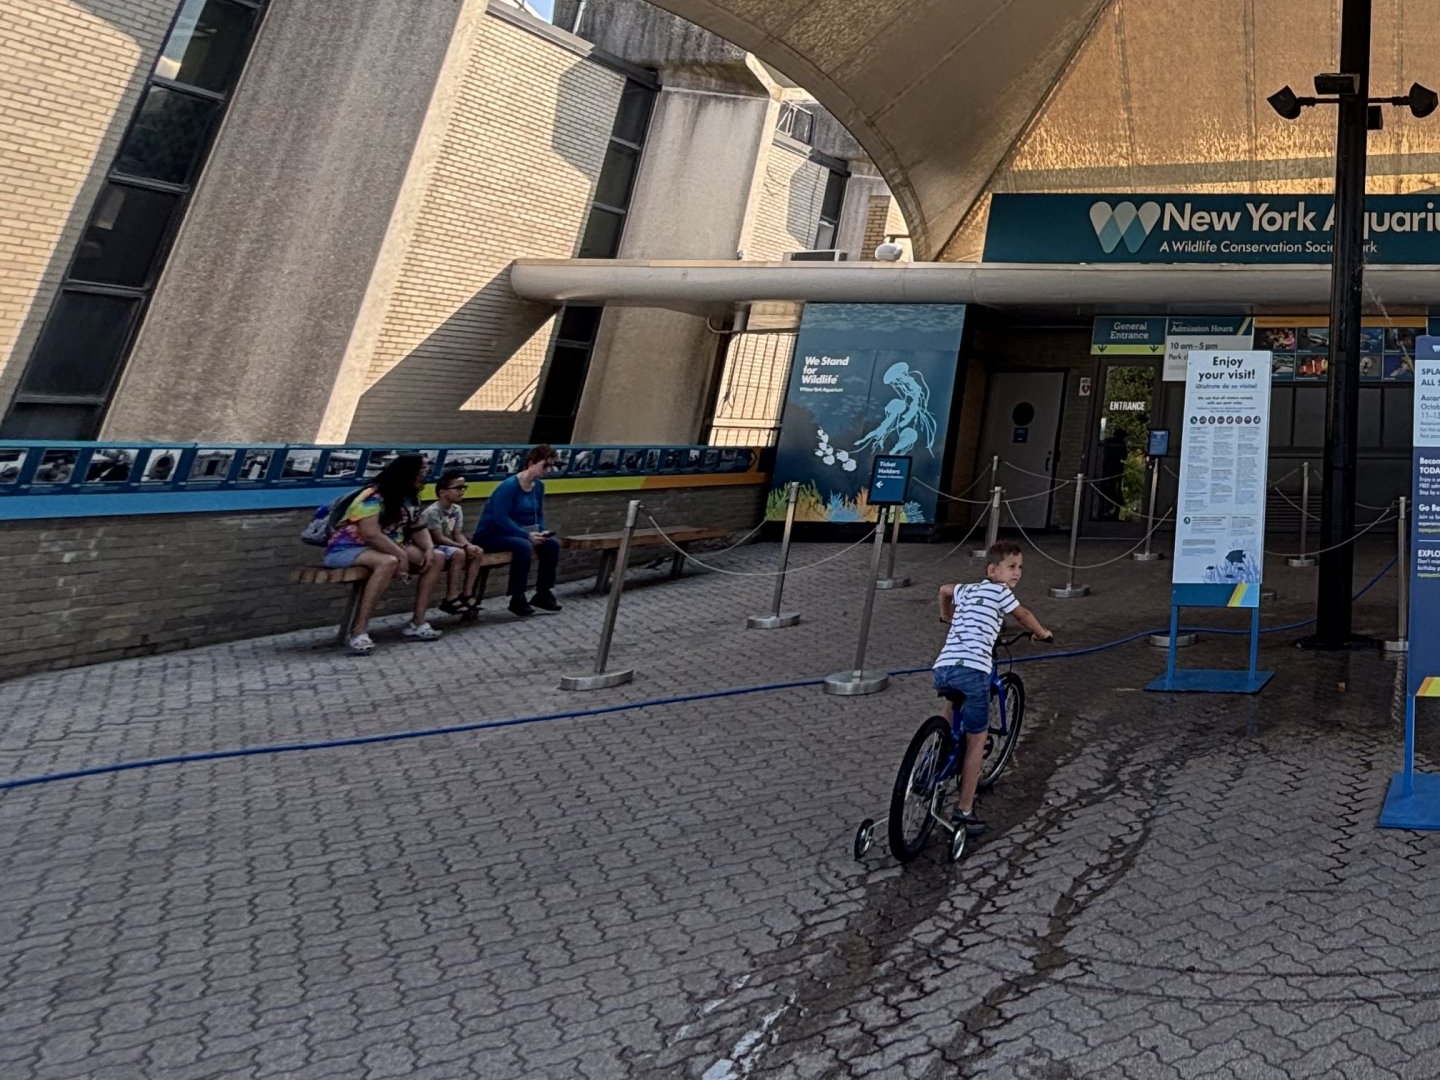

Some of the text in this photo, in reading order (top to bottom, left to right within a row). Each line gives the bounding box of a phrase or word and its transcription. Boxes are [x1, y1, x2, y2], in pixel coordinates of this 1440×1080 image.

[1162, 202, 1241, 232] New
[1245, 201, 1317, 232] York
[1160, 241, 1169, 253] A
[1172, 240, 1217, 253] Wildlife
[1221, 241, 1302, 253] Conservation
[1305, 241, 1334, 253] Soci
[1114, 322, 1147, 331] General
[1171, 324, 1233, 333] Admission Hours
[1110, 331, 1149, 340] Entrance
[1170, 342, 1179, 350] 10
[1199, 342, 1204, 350] 5
[1205, 343, 1218, 351] pm
[805, 356, 849, 365] We Stand
[1168, 353, 1181, 361] Park
[1213, 356, 1243, 368] Enjoy
[803, 366, 817, 374] for
[1199, 369, 1255, 382] your visit!
[1421, 379, 1435, 387] ALL
[1110, 401, 1146, 410] ENTRANCE
[1419, 504, 1430, 512] Go
